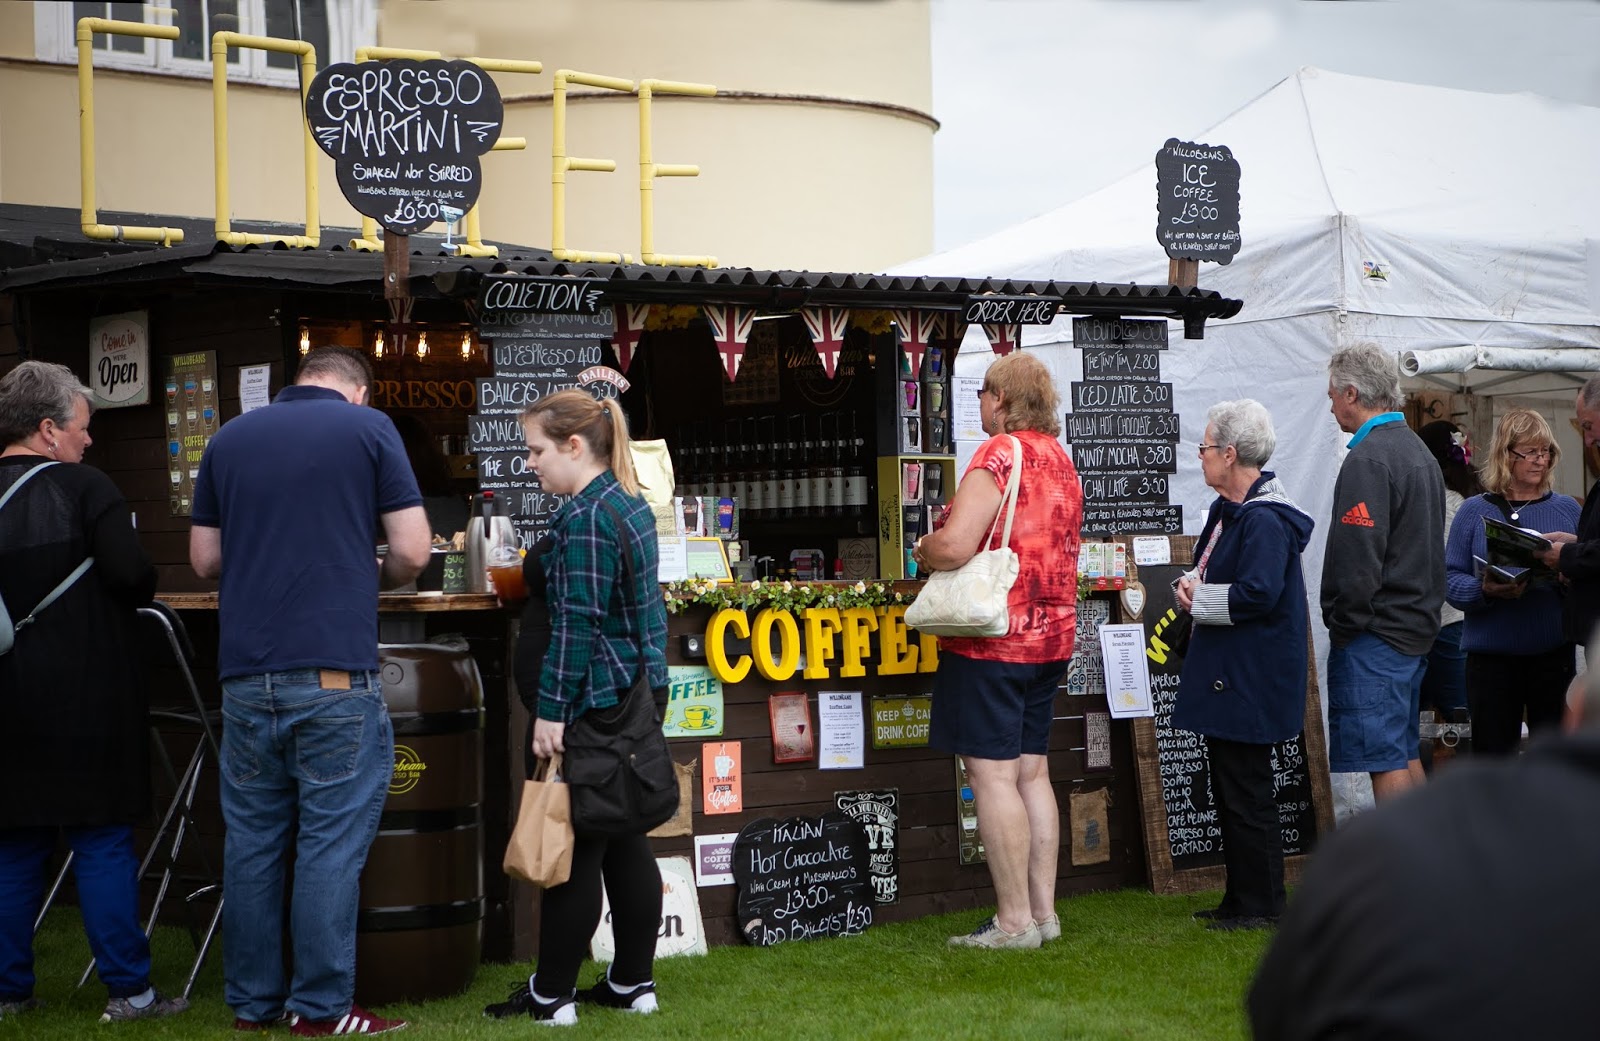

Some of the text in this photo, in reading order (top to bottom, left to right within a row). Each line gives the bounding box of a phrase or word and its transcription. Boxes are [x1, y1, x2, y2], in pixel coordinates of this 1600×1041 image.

[322, 68, 483, 121] ESPRESSO
[353, 162, 400, 182] SHAKEN
[1183, 163, 1217, 187] ICE
[1173, 184, 1219, 203] COFFEE
[966, 301, 1052, 325] ORDER HERE
[1077, 321, 1091, 342] MR
[1093, 319, 1140, 341] BUMBLES
[101, 329, 137, 352] Come in
[173, 353, 206, 367] WILLOBEANS
[515, 343, 576, 366] ESPRESSO
[98, 356, 138, 395] Open
[580, 369, 628, 390] BAILEYS
[371, 380, 477, 410] PRESSO
[481, 380, 541, 406] BAILEYS
[1079, 385, 1108, 407] ICED
[1110, 384, 1141, 406] LATTE
[1069, 414, 1097, 438] ITALIAN
[1100, 414, 1114, 436] HOT
[1117, 415, 1154, 437] CHOCOLATE
[184, 435, 204, 447] COFFEE
[1077, 445, 1172, 468] MINTY MOCHA 3.80
[481, 456, 504, 477] THE
[1084, 476, 1166, 500] CHAI LATTE 3.50
[520, 493, 547, 516] APPLE
[1099, 509, 1110, 519] ADD
[1111, 510, 1116, 519] A
[1341, 515, 1375, 527] adidas
[446, 555, 464, 564] SUG
[1076, 609, 1098, 621] KEEP
[1083, 642, 1096, 650] AND
[1075, 656, 1104, 669] DRINK
[671, 678, 717, 701] FFEE
[1151, 673, 1181, 690] AMERICA
[1152, 690, 1178, 705] CAPPUC
[876, 709, 899, 723] KEEP
[1155, 715, 1172, 727] FLAT
[877, 726, 929, 741] DRINK COFF
[1156, 728, 1173, 739] LONG
[1160, 761, 1203, 776] ESPRESSO
[1162, 775, 1192, 788] DOPPIO
[708, 788, 739, 810] Coffee
[1166, 798, 1196, 813] VIENA
[847, 804, 860, 818] LL
[873, 803, 889, 817] NEED
[862, 814, 870, 823] IS
[772, 818, 824, 844] ITALIAN
[864, 824, 894, 850] VE
[1168, 827, 1204, 842] ESPRESSO
[1170, 840, 1213, 857] CORTADO
[703, 855, 731, 864] COFF
[750, 841, 854, 877] HOT CHOCOLATE
[766, 875, 792, 892] CREAM
[762, 924, 788, 946] ADD
